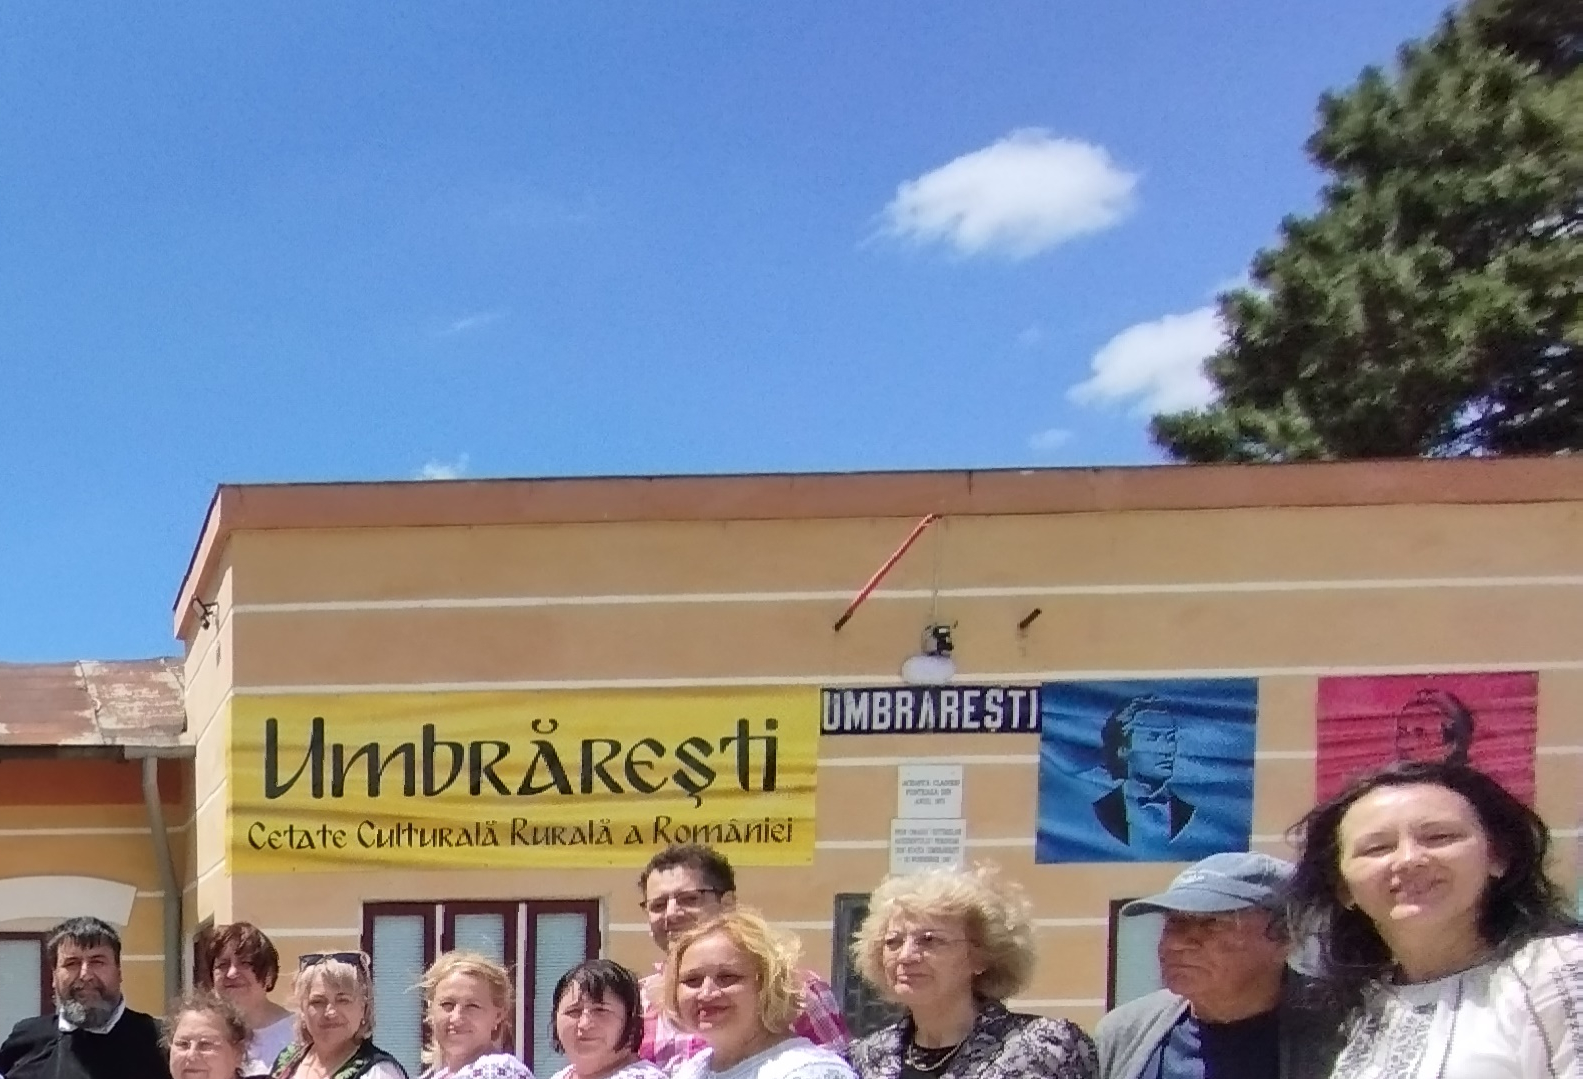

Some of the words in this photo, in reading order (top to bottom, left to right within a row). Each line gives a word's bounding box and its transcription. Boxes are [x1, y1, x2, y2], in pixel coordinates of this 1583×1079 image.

[248, 820, 347, 850] Cetate
[356, 819, 500, 849] Culturală
[510, 816, 614, 846] Rurală
[623, 824, 644, 845] a
[652, 815, 793, 844] României
